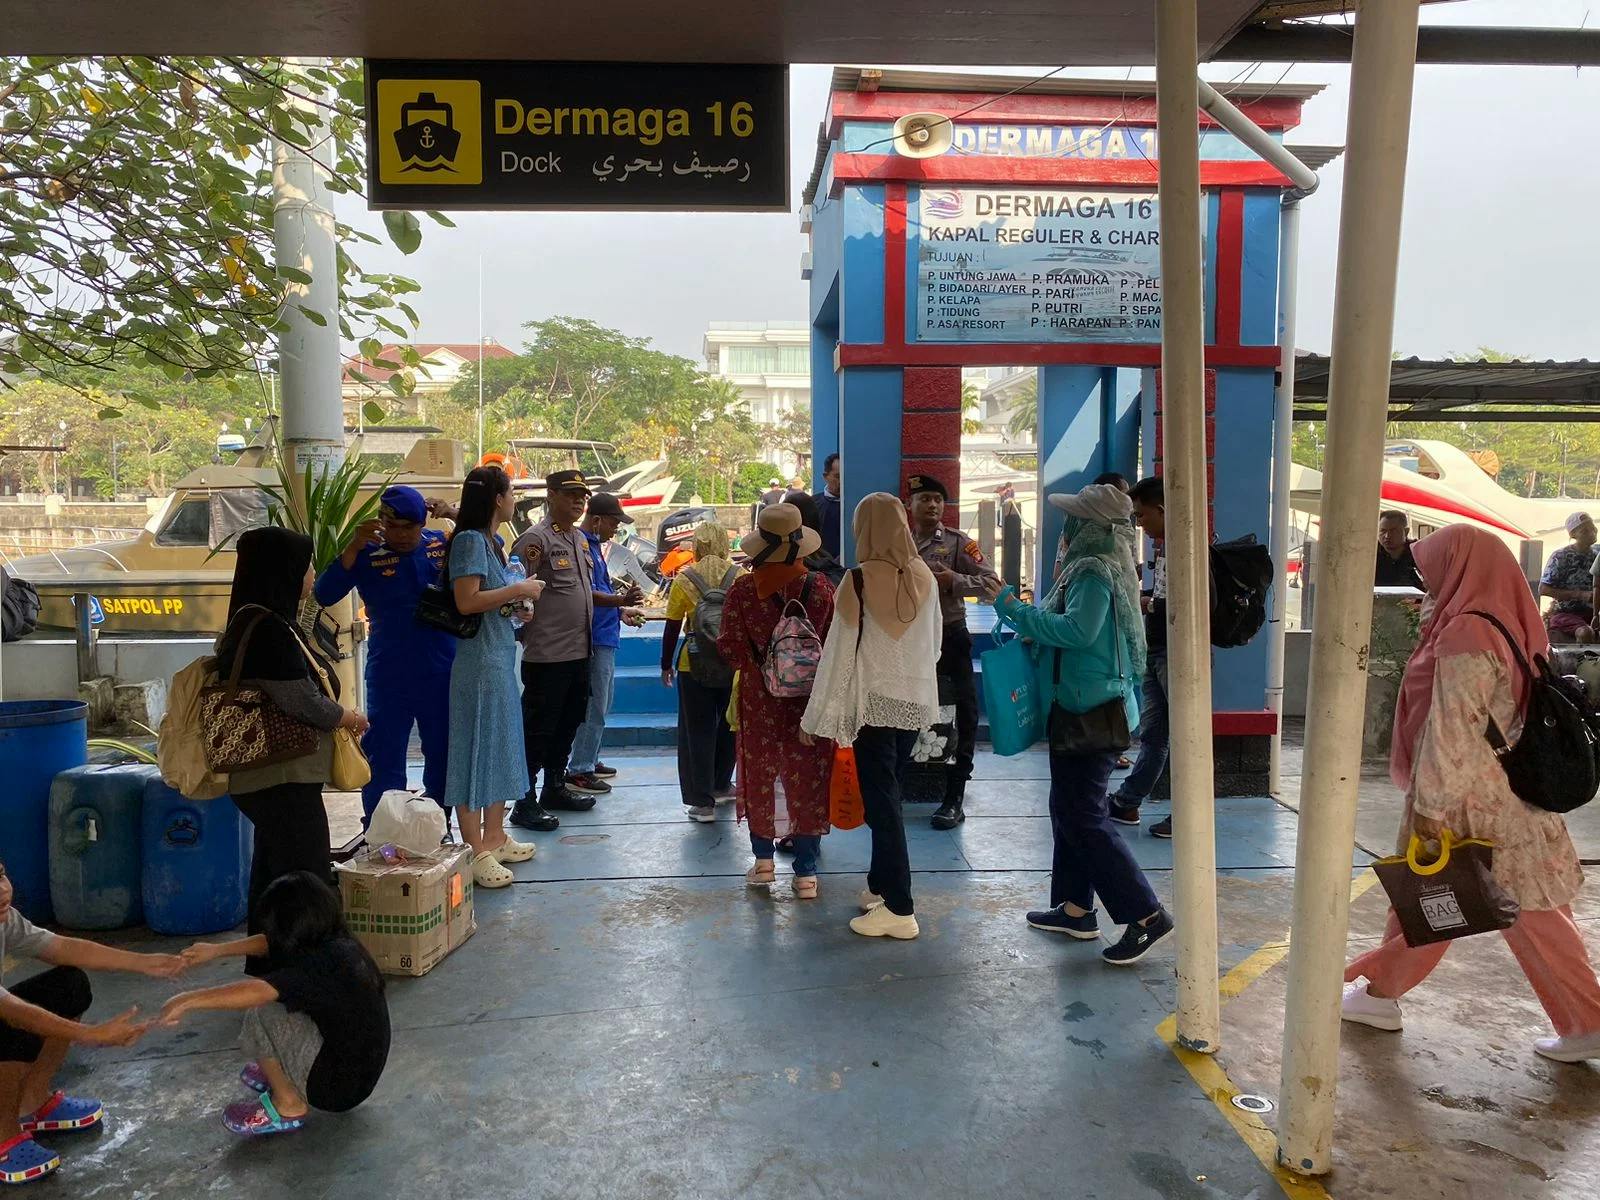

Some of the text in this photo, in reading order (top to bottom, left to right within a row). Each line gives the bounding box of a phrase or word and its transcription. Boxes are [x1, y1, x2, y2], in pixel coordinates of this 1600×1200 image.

[494, 98, 754, 146] Dermaga 16
[954, 126, 1159, 160] DERMAGA 1
[501, 151, 562, 173] Dock
[592, 150, 752, 182] رصيف بحري
[975, 194, 1153, 220] DERMAGA 16
[928, 226, 1160, 246] KAPAL REGULER & CHAR
[927, 251, 974, 263] TUJUAN
[928, 271, 1017, 281] P. UNTUNG JAWA
[1032, 274, 1110, 285] P. PRAMUKA
[927, 283, 937, 293] P.
[938, 283, 991, 293] BIDADARI
[998, 284, 1026, 294] AYER
[1137, 279, 1160, 289] PEL
[1032, 288, 1042, 299] P.
[1045, 288, 1075, 299] PARI
[1120, 292, 1161, 302] P. MAC
[927, 295, 982, 305] P. KELAPA
[1031, 302, 1083, 314] P. PUTRI
[1120, 305, 1129, 315] P.
[926, 319, 1006, 330] P. ASA RESORT
[1050, 318, 1112, 328] HARAPAN
[1136, 319, 1160, 329] PAN
[665, 520, 706, 536] SUZU
[102, 598, 183, 615] SATPOL PP
[1424, 900, 1461, 919] BAG
[400, 956, 412, 968] 60
